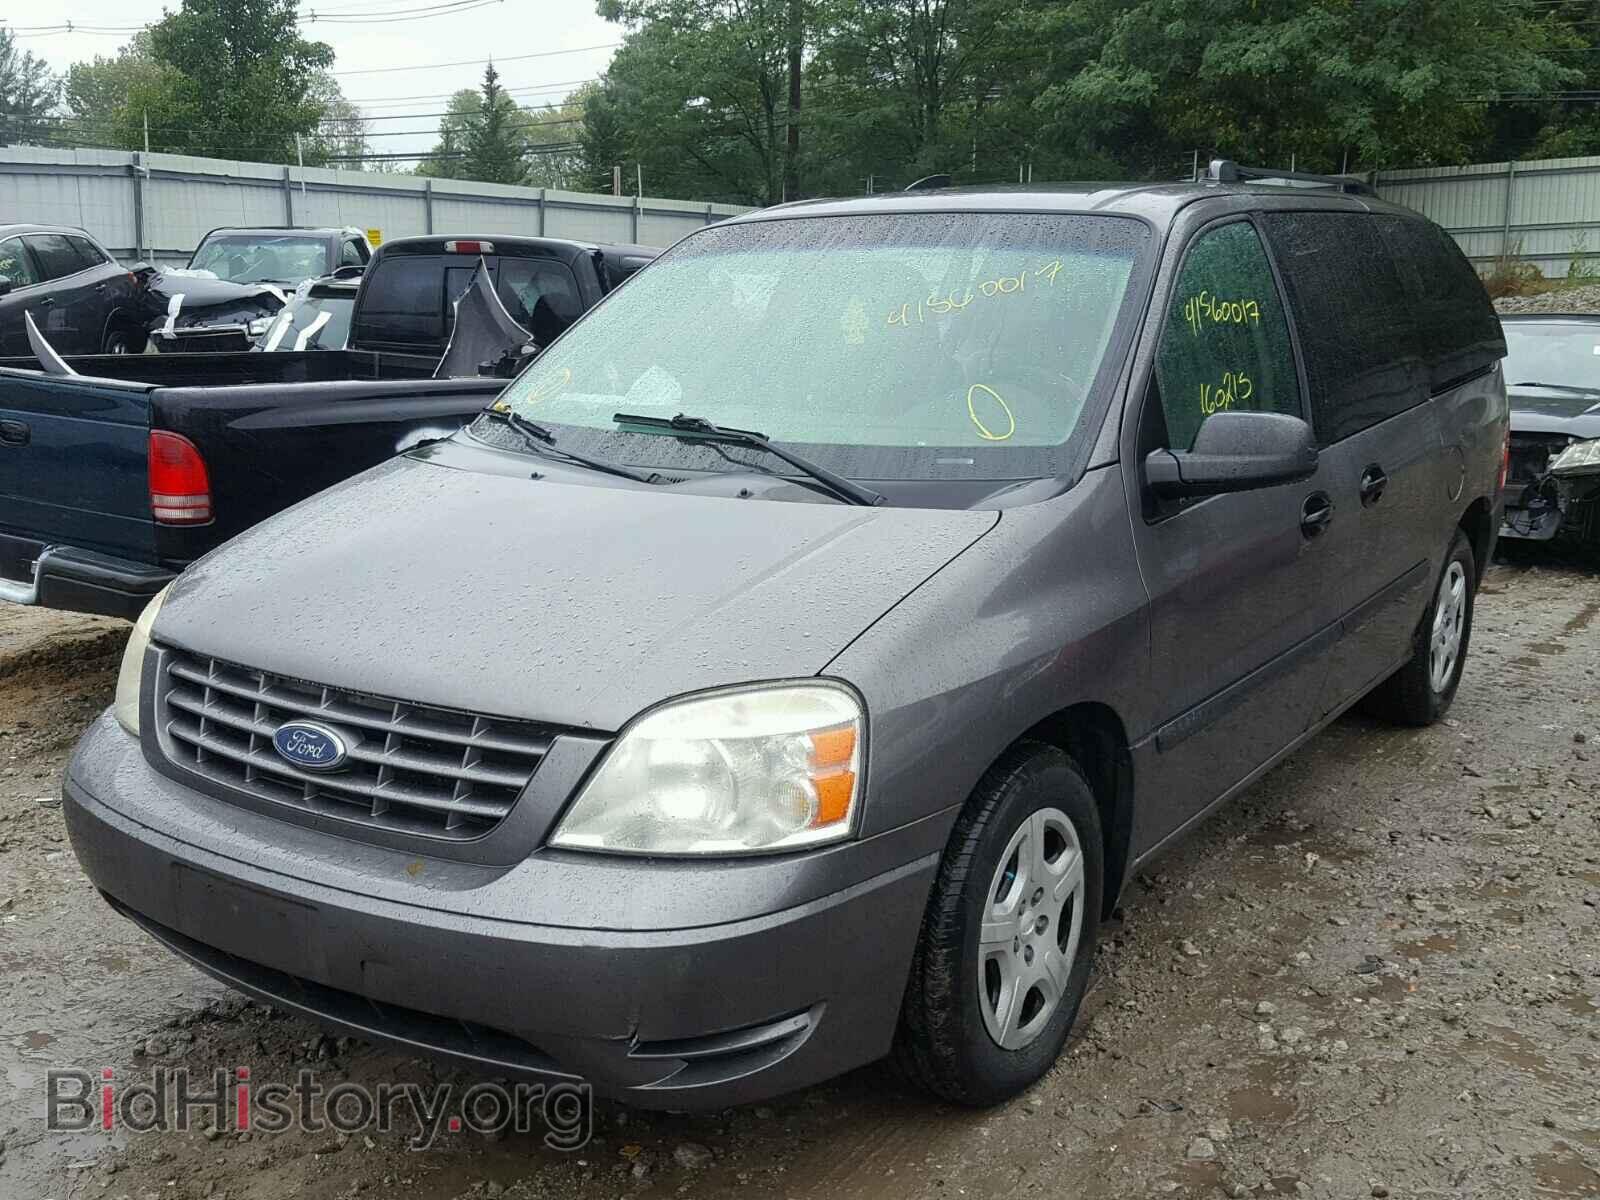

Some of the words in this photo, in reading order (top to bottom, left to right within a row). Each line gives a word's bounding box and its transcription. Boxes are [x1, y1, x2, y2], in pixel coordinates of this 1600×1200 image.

[1185, 290, 1260, 337] 41560017
[1200, 372, 1252, 416] 160215
[286, 730, 327, 759] Ford
